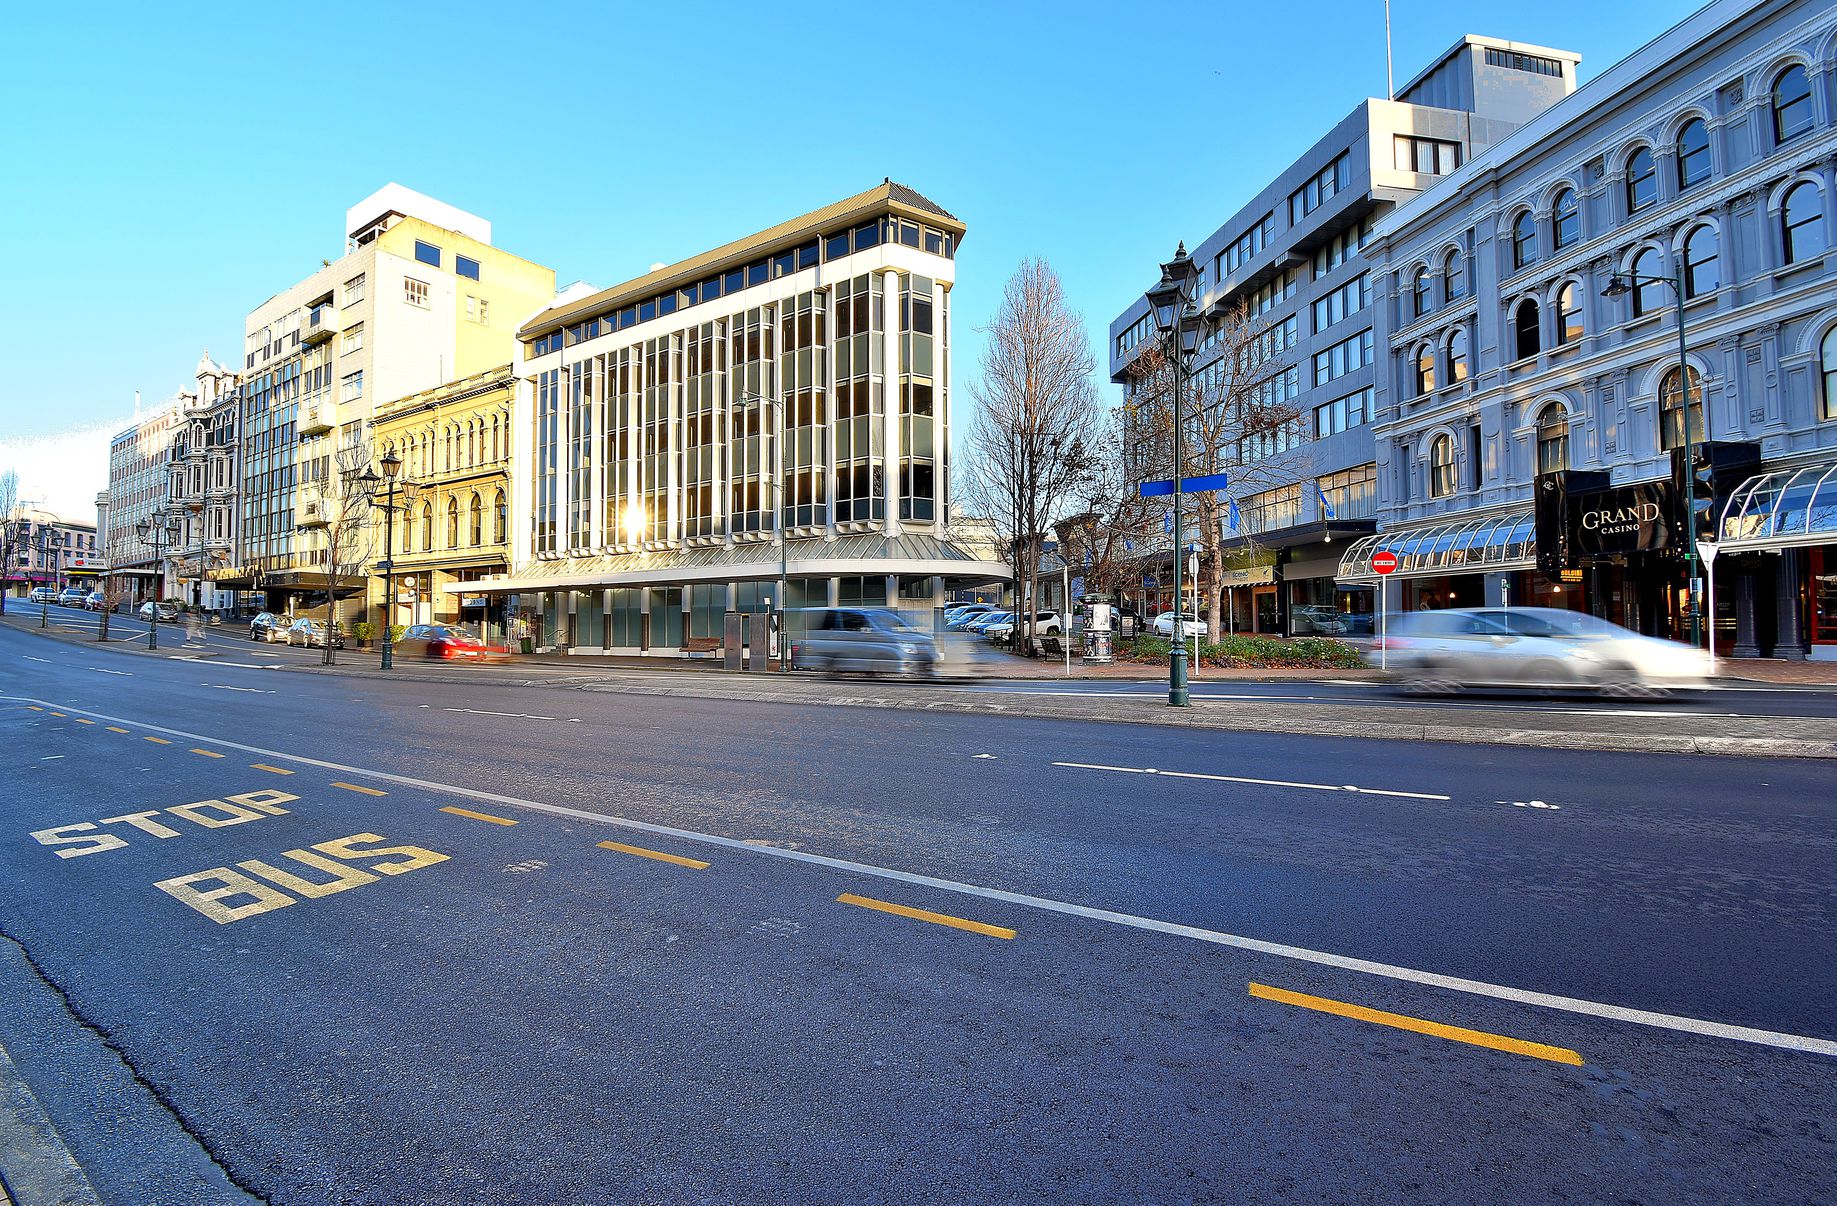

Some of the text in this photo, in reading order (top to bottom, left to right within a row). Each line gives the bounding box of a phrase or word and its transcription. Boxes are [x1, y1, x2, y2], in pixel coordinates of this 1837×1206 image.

[1582, 502, 1660, 530] GRAND
[1601, 523, 1640, 535] CASINO
[29, 789, 301, 858] STOP
[153, 833, 452, 925] BUS
